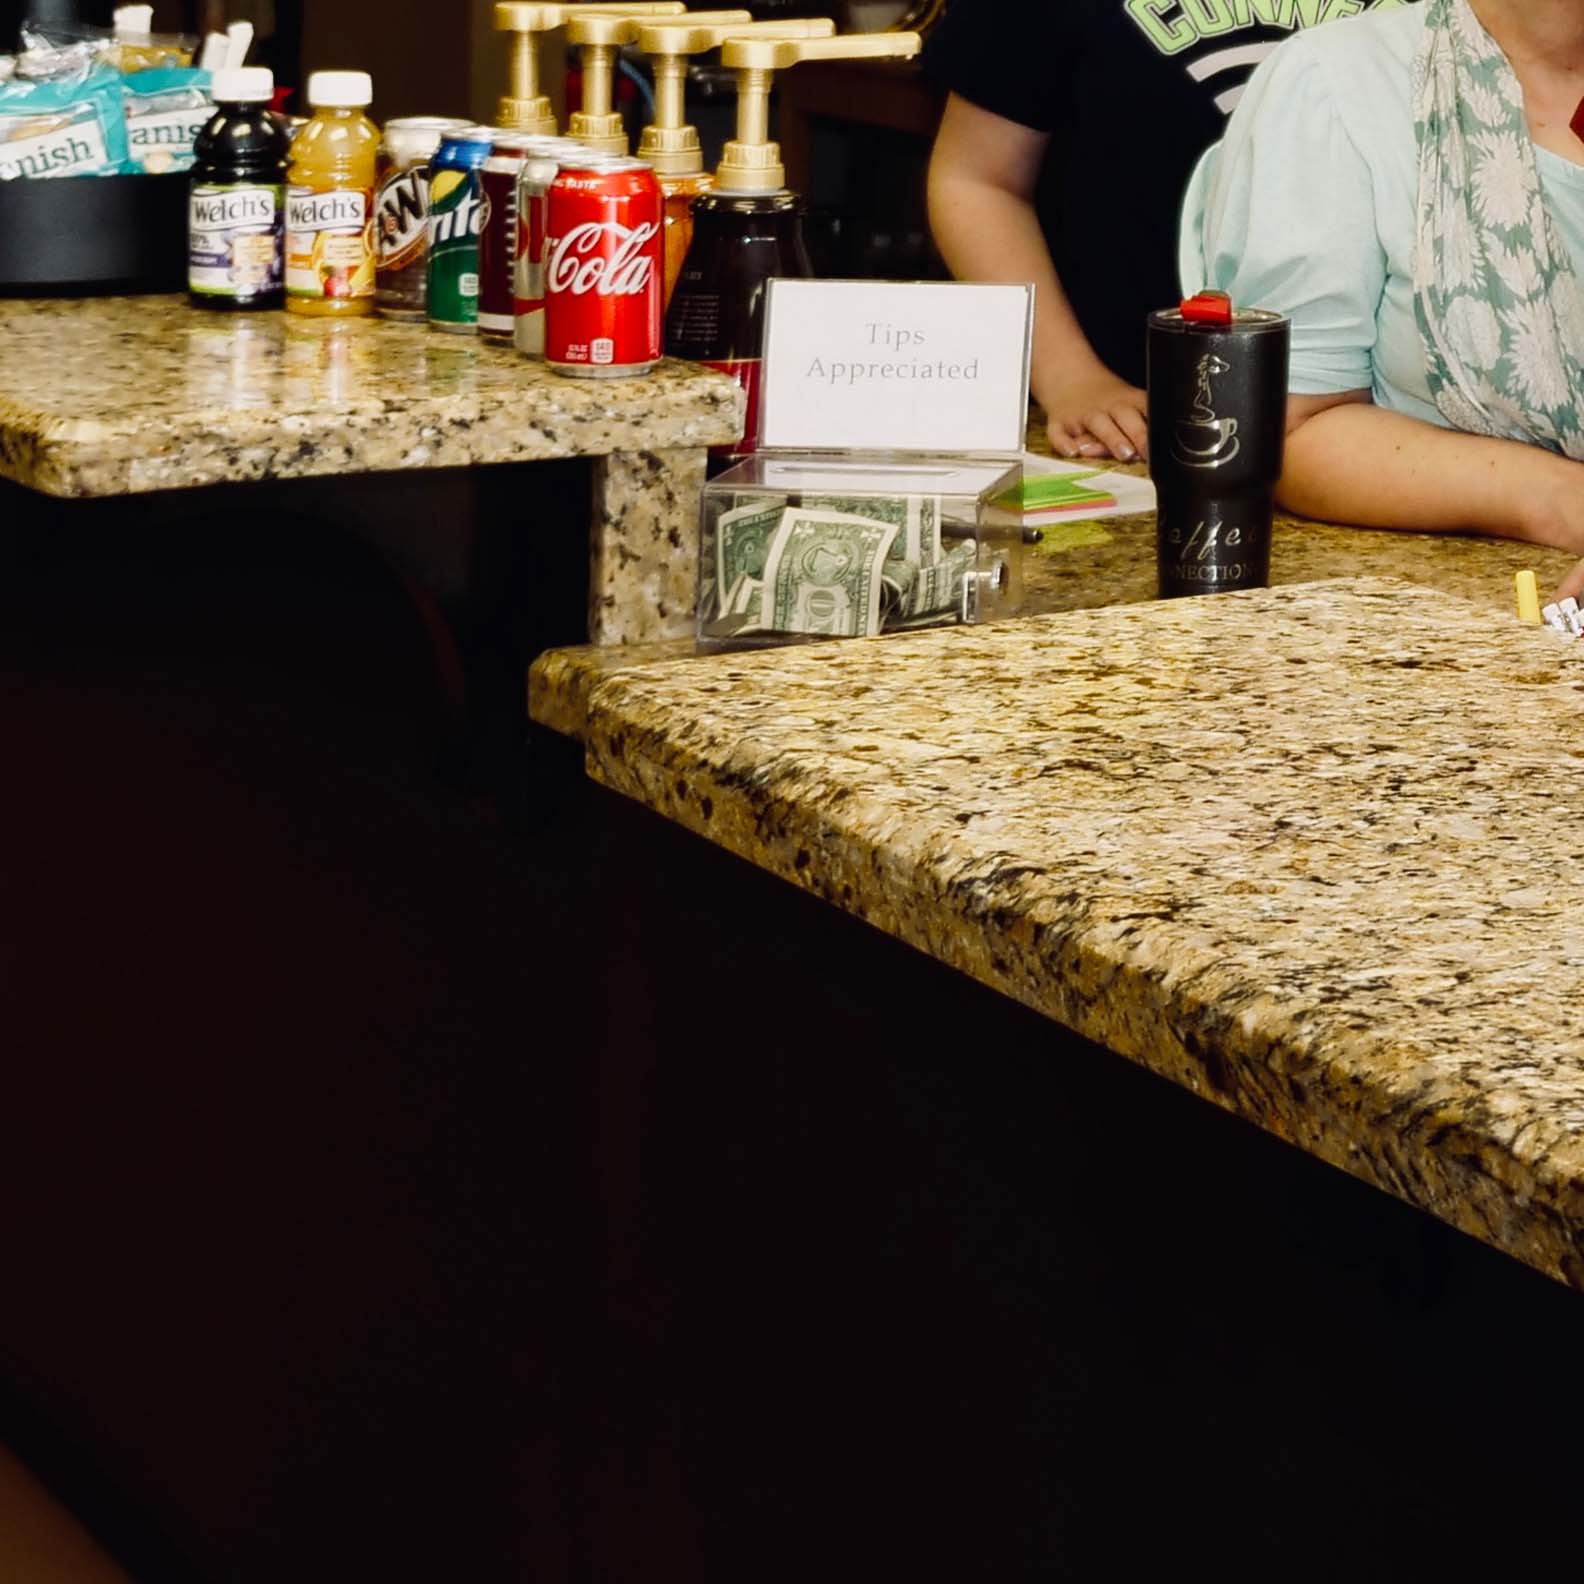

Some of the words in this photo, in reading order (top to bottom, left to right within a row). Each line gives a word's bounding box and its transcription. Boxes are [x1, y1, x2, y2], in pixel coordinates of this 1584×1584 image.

[193, 197, 271, 223] Welch's
[288, 198, 361, 224] Welch's
[865, 321, 926, 351] Tips
[807, 356, 979, 384] Appreciated
